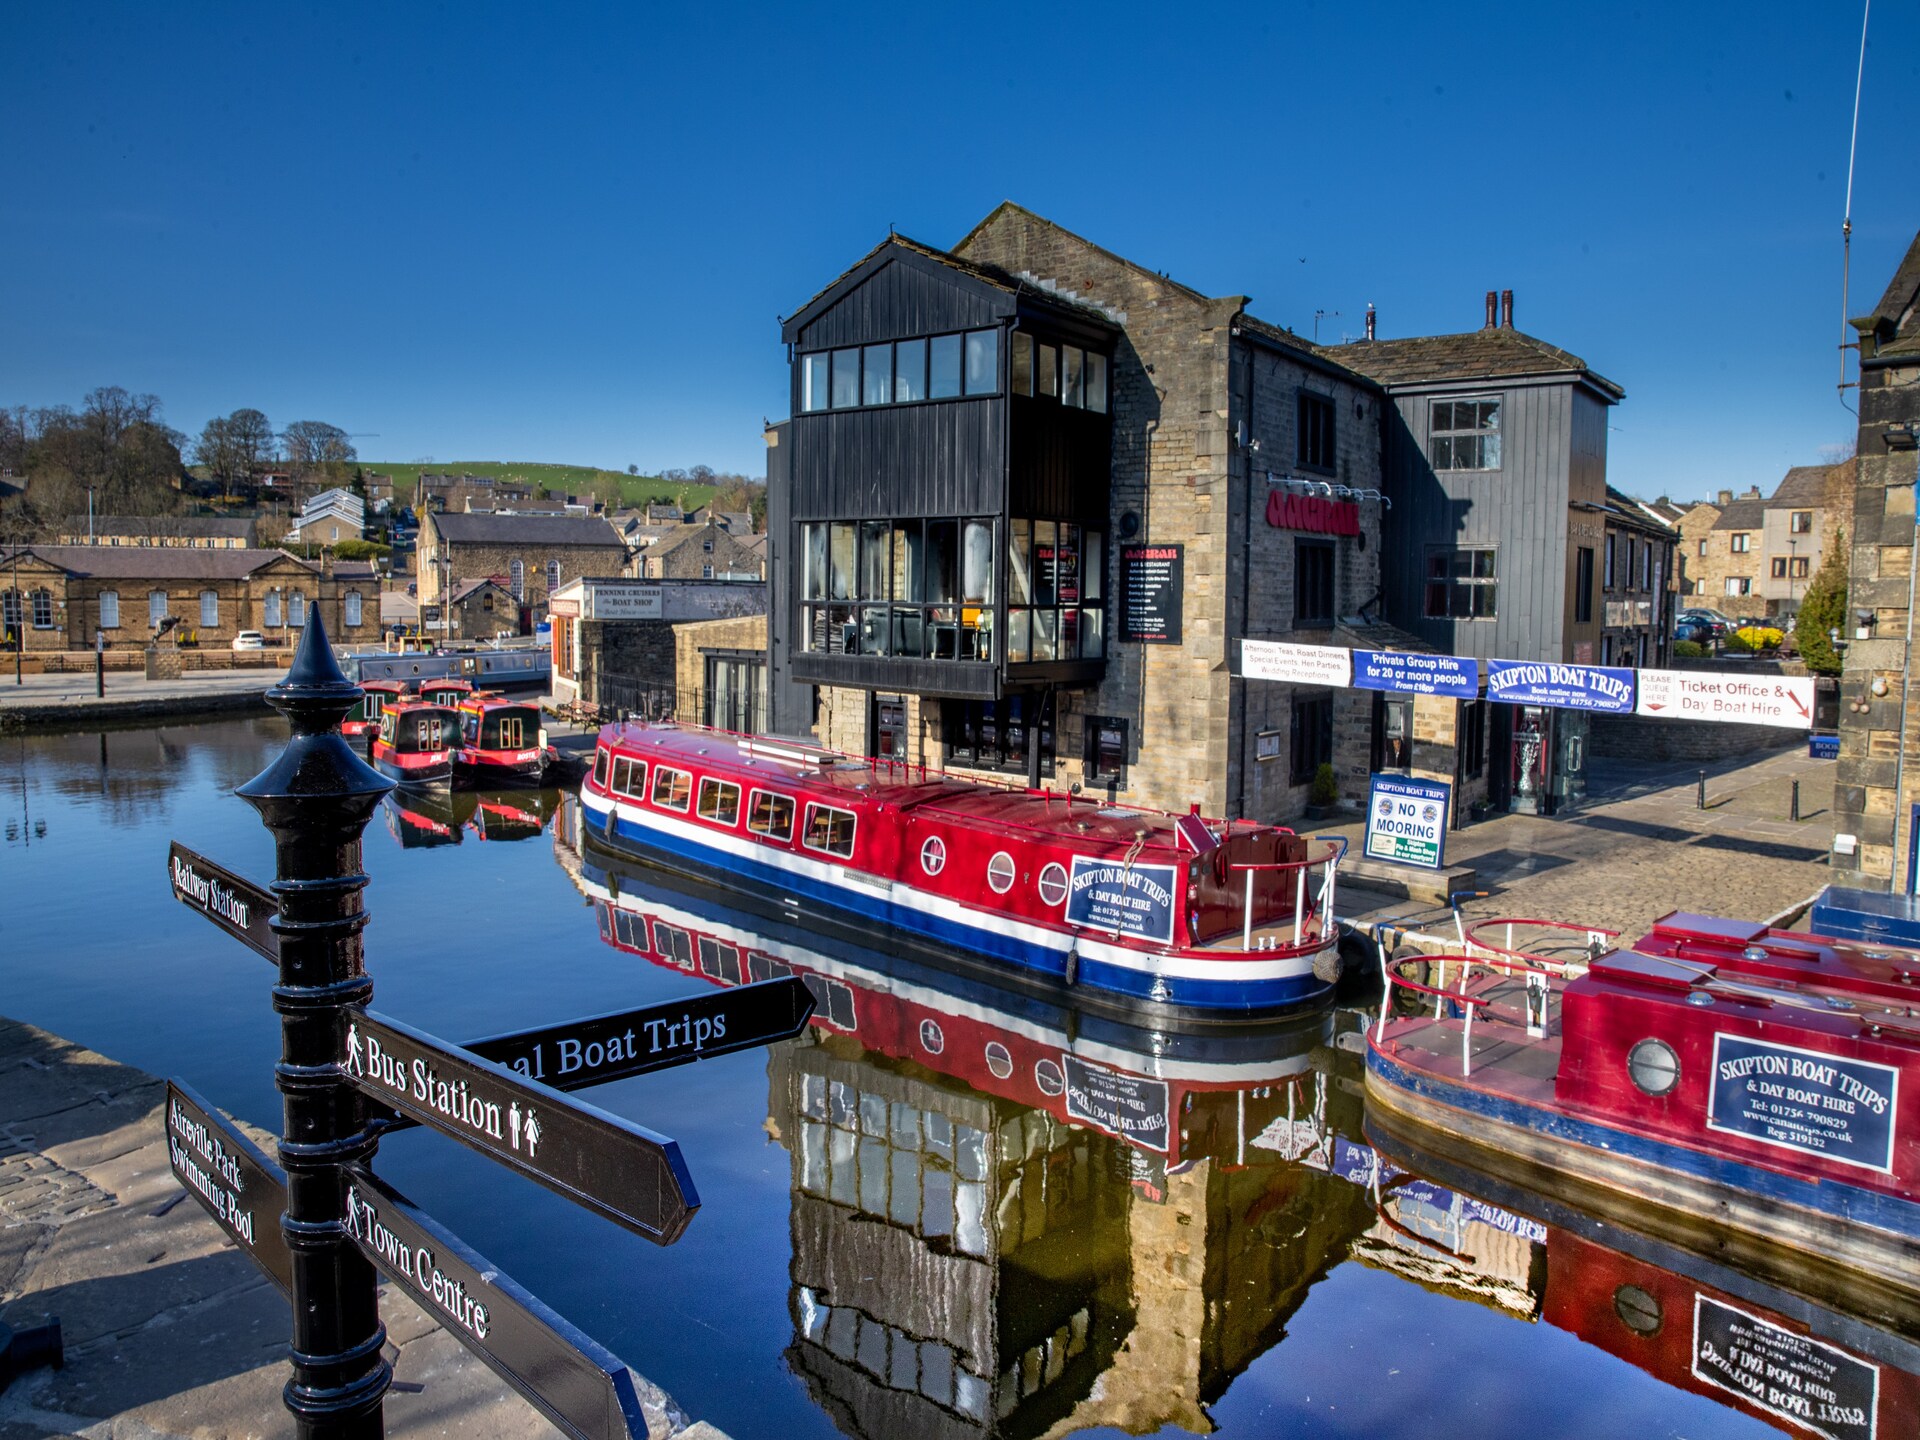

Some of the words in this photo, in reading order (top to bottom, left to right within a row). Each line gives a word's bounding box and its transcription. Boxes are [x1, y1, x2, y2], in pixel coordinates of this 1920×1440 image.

[1250, 655, 1273, 664] Special
[1302, 659, 1315, 667] Hen
[1297, 649, 1317, 658] Roast
[1372, 654, 1405, 666] Private
[1407, 657, 1437, 670] Group
[1439, 659, 1459, 671] Hire
[1262, 667, 1290, 676] Wedding
[1292, 669, 1330, 679] Receptions
[1367, 666, 1380, 677] for
[1382, 668, 1393, 678] 20
[1395, 671, 1405, 679] or
[1408, 672, 1431, 681] more
[1434, 674, 1467, 686] people
[1641, 675, 1672, 683] PLEASE
[1396, 682, 1413, 690] From
[1490, 666, 1547, 692] SKIPTON
[1549, 666, 1587, 687] BOAT
[1589, 672, 1632, 703] TRIPS
[1532, 687, 1548, 696] Book
[1550, 689, 1570, 697] online
[1644, 684, 1670, 693] QUEUE
[1680, 680, 1722, 694] Ticket
[1726, 683, 1769, 697] Office
[1774, 686, 1785, 698] &
[1499, 693, 1565, 704] www.canaltrips.co.uk
[1593, 700, 1620, 709] 790829
[1646, 694, 1667, 702] HERE
[1682, 698, 1709, 713] Day
[1714, 700, 1747, 713] Boat
[1752, 702, 1781, 716] Hire
[1377, 783, 1405, 794] SKIPTON
[1407, 787, 1424, 797] BOAT
[1426, 790, 1445, 799] TRIPS
[1399, 803, 1416, 817] NO
[1377, 819, 1434, 839] MOORING
[174, 856, 210, 911] Railway
[211, 879, 248, 930] Station
[1073, 868, 1115, 892] SKIPTON
[1116, 869, 1143, 889] BOAT
[1143, 878, 1172, 908] TRIPS
[1088, 889, 1095, 900] &
[1096, 891, 1111, 902] DAY
[1111, 894, 1131, 907] BOAT
[1132, 898, 1151, 912] HIRE
[1103, 907, 1120, 917] 01756
[1088, 913, 1144, 931] www.canaltrps.co.uk
[500, 1044, 546, 1080] al
[557, 1029, 637, 1075] Boat
[644, 1014, 727, 1054] Trips
[367, 1036, 407, 1092] Bus
[413, 1058, 503, 1140] Station
[1720, 1055, 1789, 1080] SKIPTON
[1791, 1059, 1837, 1087] BOAT
[1839, 1073, 1889, 1115] TRIPS
[1747, 1080, 1757, 1092] &
[1759, 1082, 1785, 1099] DAY
[1786, 1089, 1822, 1106] BOAT
[1823, 1096, 1856, 1115] HIRE
[1751, 1099, 1768, 1112] Tel:
[1771, 1104, 1804, 1119] 01756
[1807, 1112, 1848, 1130] 790829
[171, 1099, 213, 1163] Aireville
[215, 1138, 242, 1193] Park
[1768, 1126, 1787, 1140] Reg:
[1789, 1132, 1825, 1149] 519132
[172, 1137, 226, 1220] Swimming
[227, 1190, 255, 1246] Pool
[363, 1201, 414, 1277] Town
[417, 1248, 487, 1339] Centre
